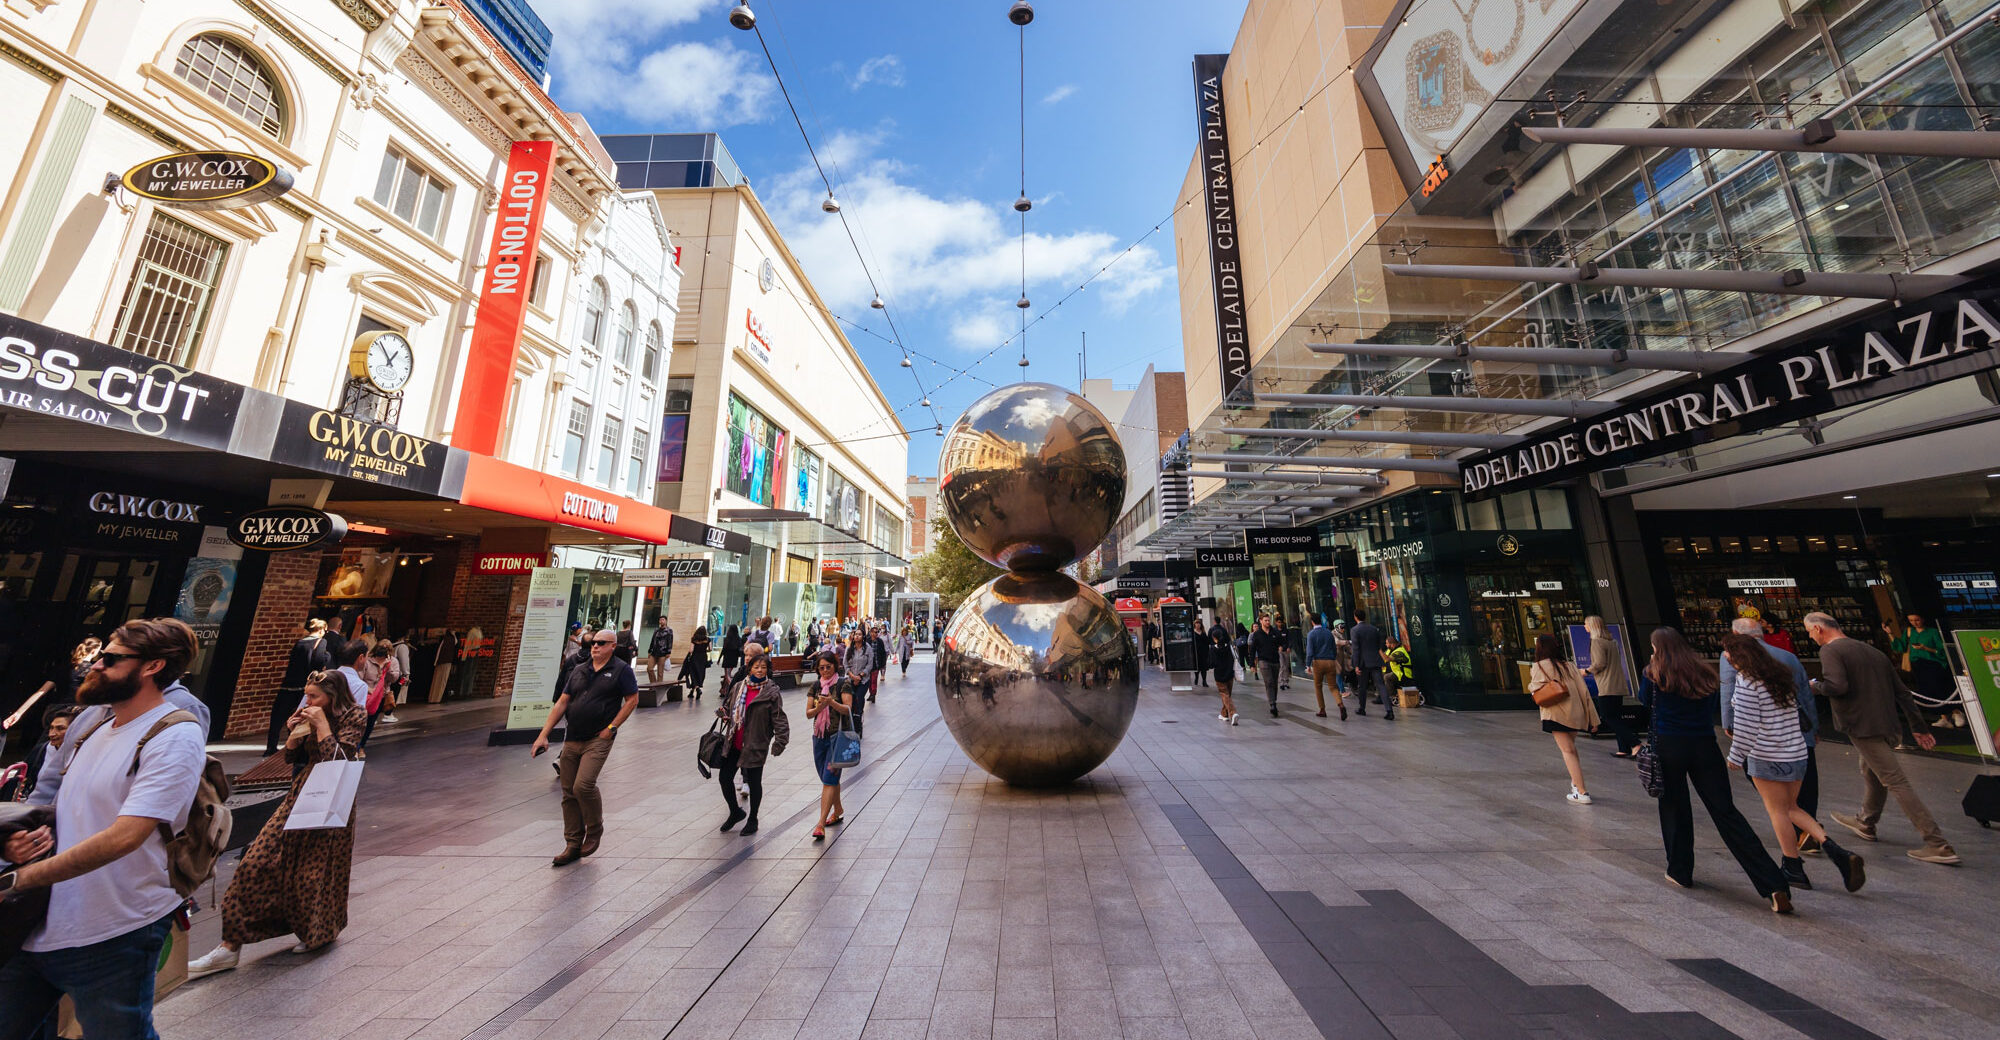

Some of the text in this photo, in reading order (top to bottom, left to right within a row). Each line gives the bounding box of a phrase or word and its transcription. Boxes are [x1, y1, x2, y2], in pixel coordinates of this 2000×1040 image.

[148, 179, 246, 191] MY JEWELLER
[1203, 76, 1246, 378] ADELAIDE CENTRAL PLAZA
[97, 365, 210, 421] CUT
[1463, 299, 2000, 494] ADELAIDE CENTRAL PLAZA
[38, 397, 112, 425] SALON
[325, 446, 408, 477] MY JEWELLER
[97, 523, 180, 541] MY JEWELLER
[244, 534, 310, 545] MY JEWELLER
[1270, 536, 1291, 544] BODY
[1201, 553, 1250, 562] CALIBRE
[1382, 544, 1402, 560] BODY
[1402, 541, 1424, 557] SHOP
[1597, 579, 1610, 588] 100
